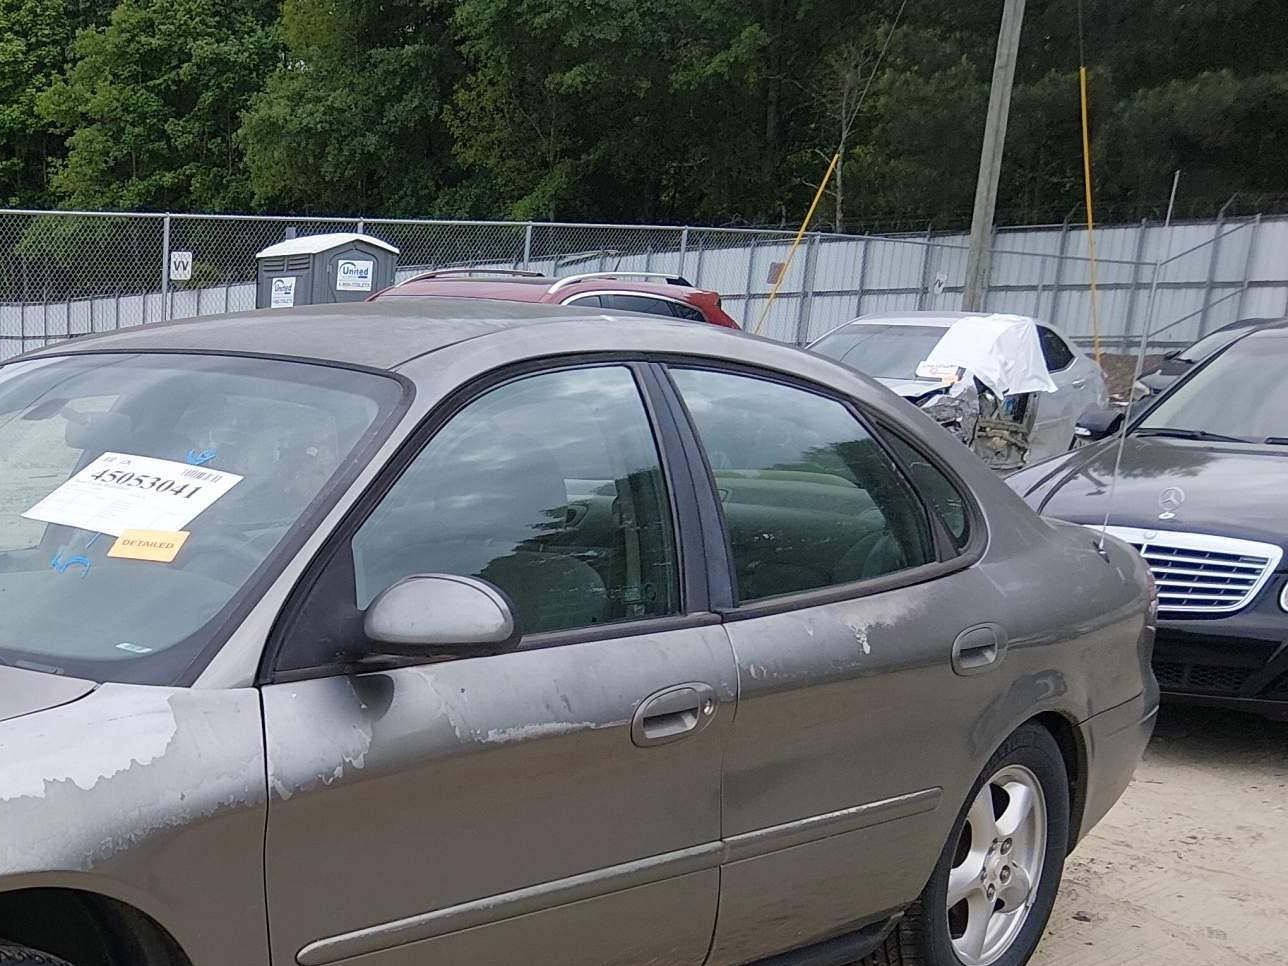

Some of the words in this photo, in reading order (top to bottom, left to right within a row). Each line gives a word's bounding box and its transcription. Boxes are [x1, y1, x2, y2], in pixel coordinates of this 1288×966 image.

[173, 261, 189, 271] VV
[342, 266, 369, 276] United
[90, 468, 203, 499] 45053041
[121, 539, 175, 549] DETAILED
